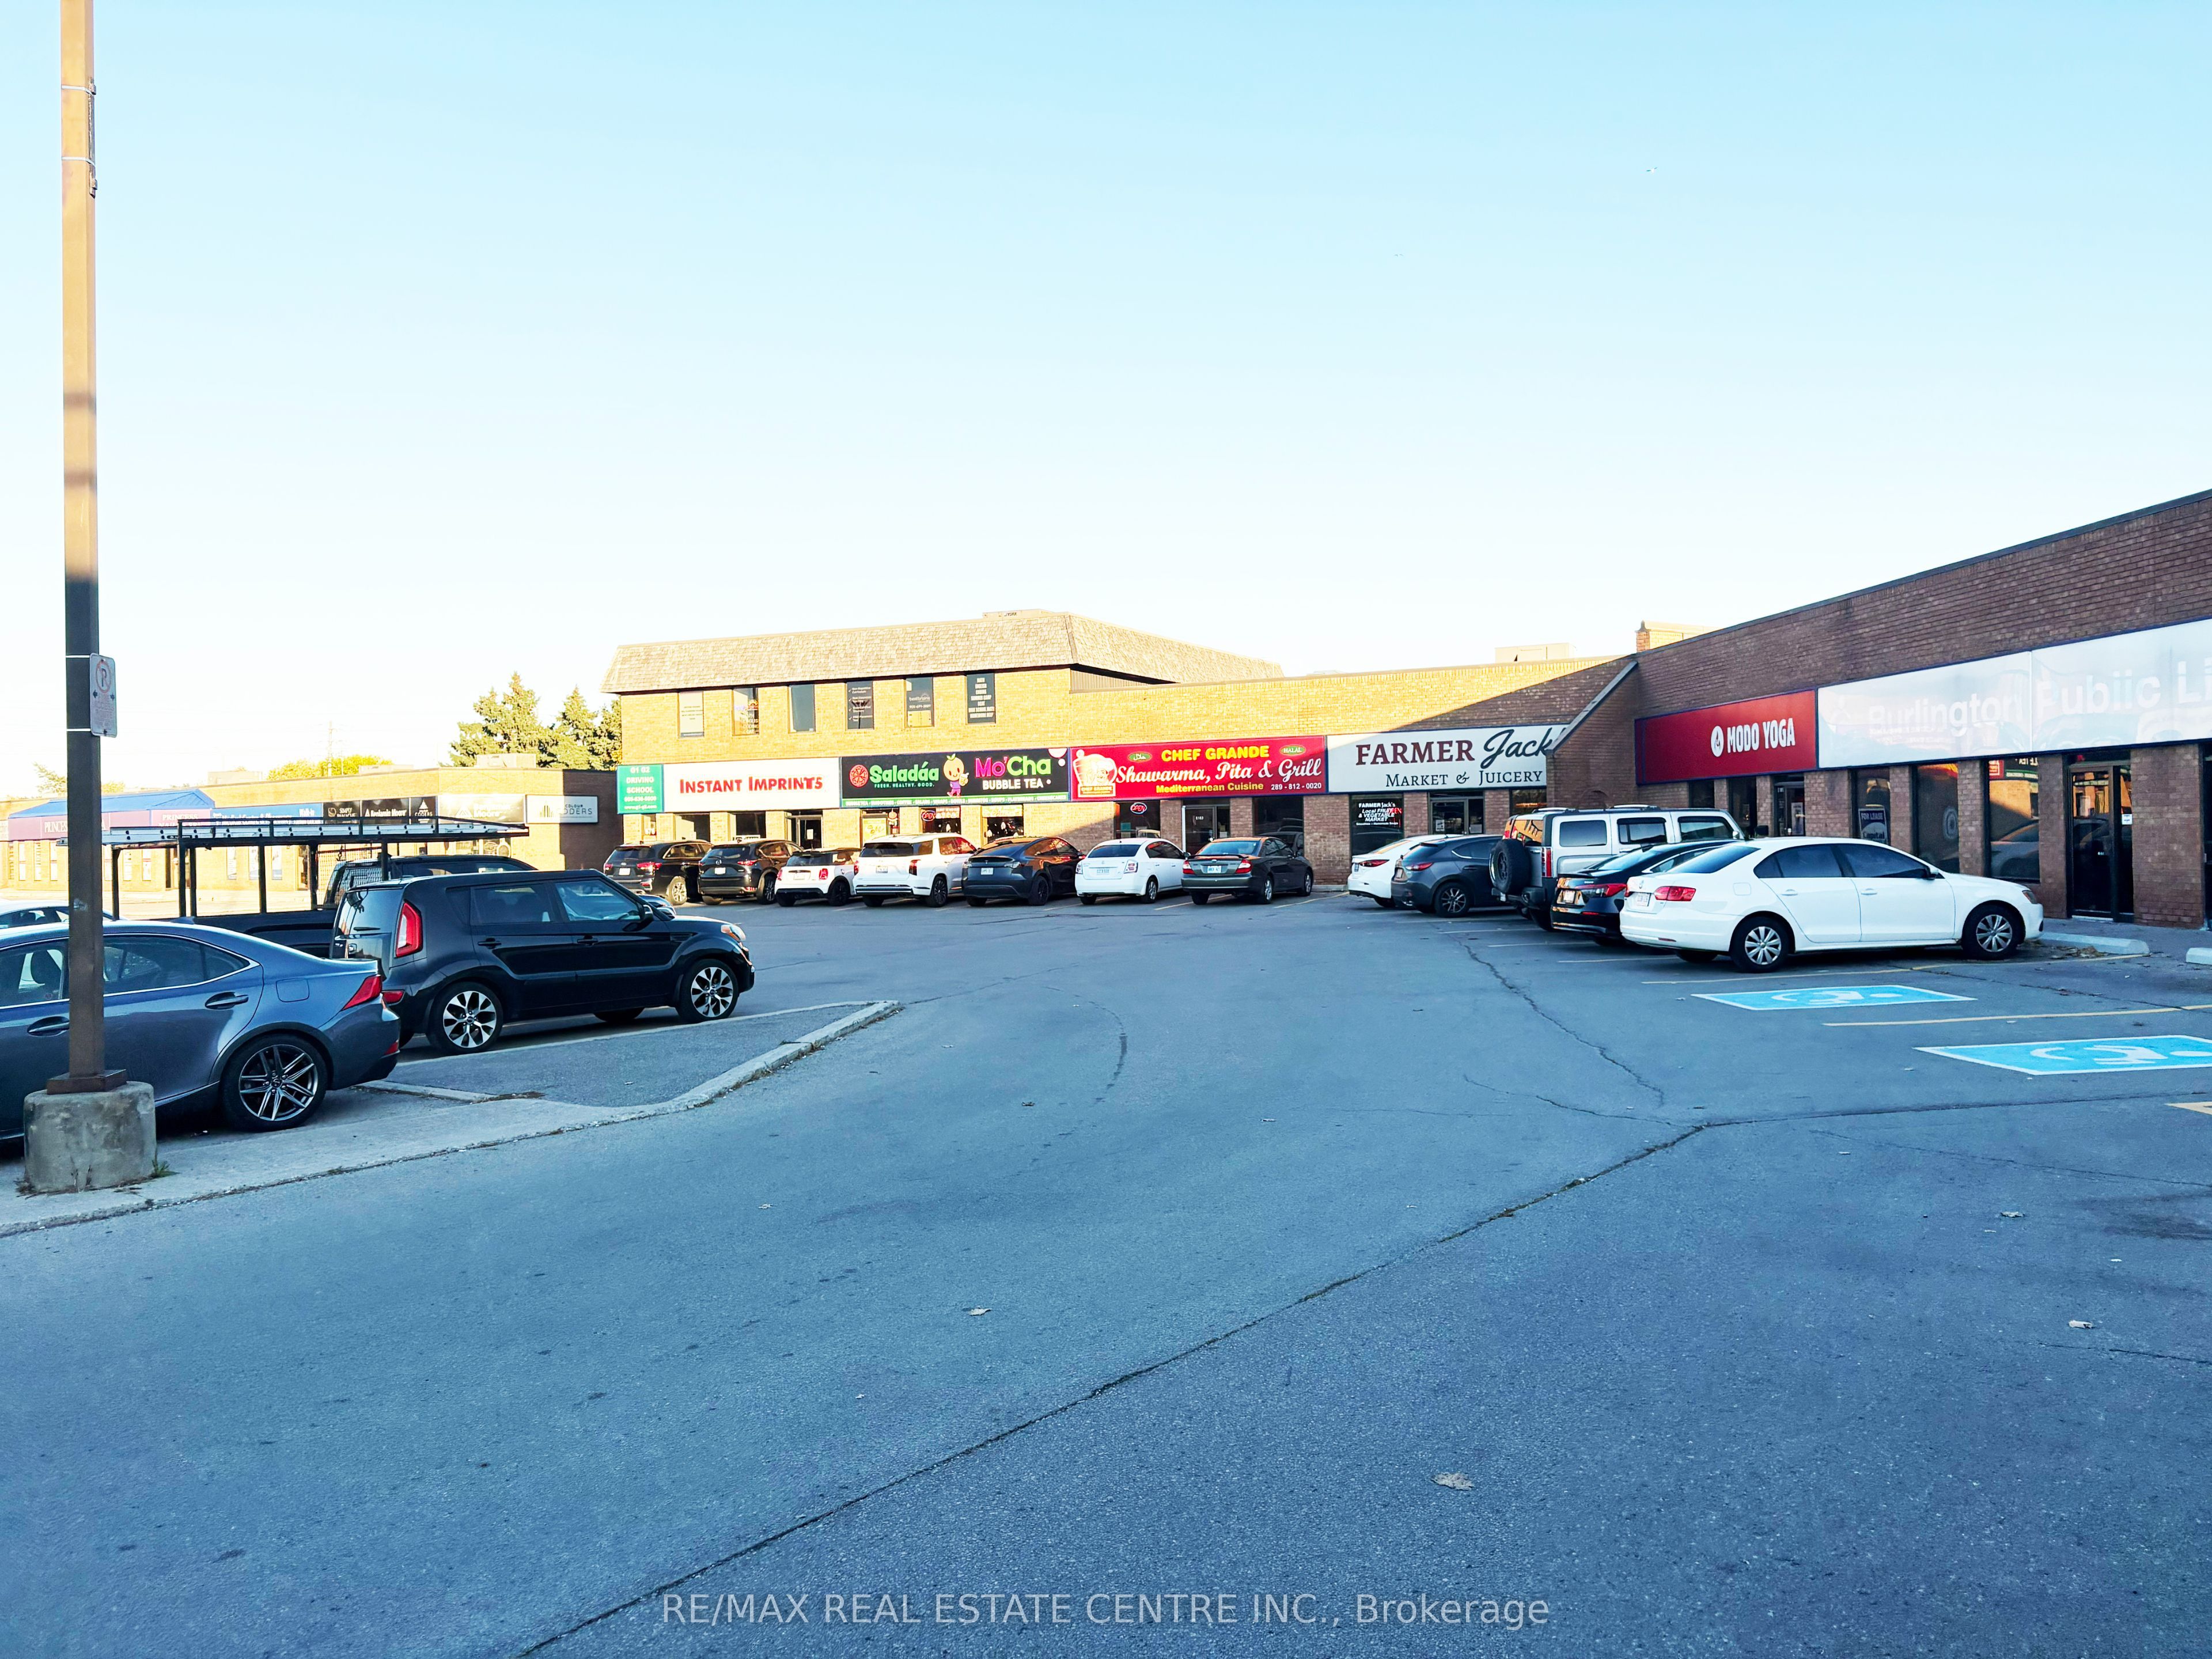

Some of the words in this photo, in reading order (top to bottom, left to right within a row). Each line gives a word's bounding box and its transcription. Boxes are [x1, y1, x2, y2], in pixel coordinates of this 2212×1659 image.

[1869, 691, 2023, 737] Burlington
[1727, 722, 1760, 753] MODO
[1763, 718, 1796, 749] YOGA
[1161, 748, 1201, 762] CHEF
[1205, 745, 1270, 760] GRANDE
[1355, 740, 1475, 766] FARMER
[869, 761, 940, 783] Saladáa
[975, 756, 1051, 778] Mo'Cha
[1116, 765, 1211, 783] Shawarma,
[1215, 762, 1253, 780] Pita
[1257, 759, 1274, 778] &
[1278, 758, 1322, 782] Grill
[626, 776, 655, 784] DRIVING
[680, 779, 743, 794] INSTANT
[982, 779, 1021, 790] BUBBLE
[1024, 778, 1044, 789] TEA
[1156, 783, 1225, 793] Mediterranean
[1228, 782, 1264, 791] Cuisine
[1386, 774, 1449, 787] MARKET
[1456, 771, 1470, 785] &
[1479, 770, 1543, 786] JUICERY
